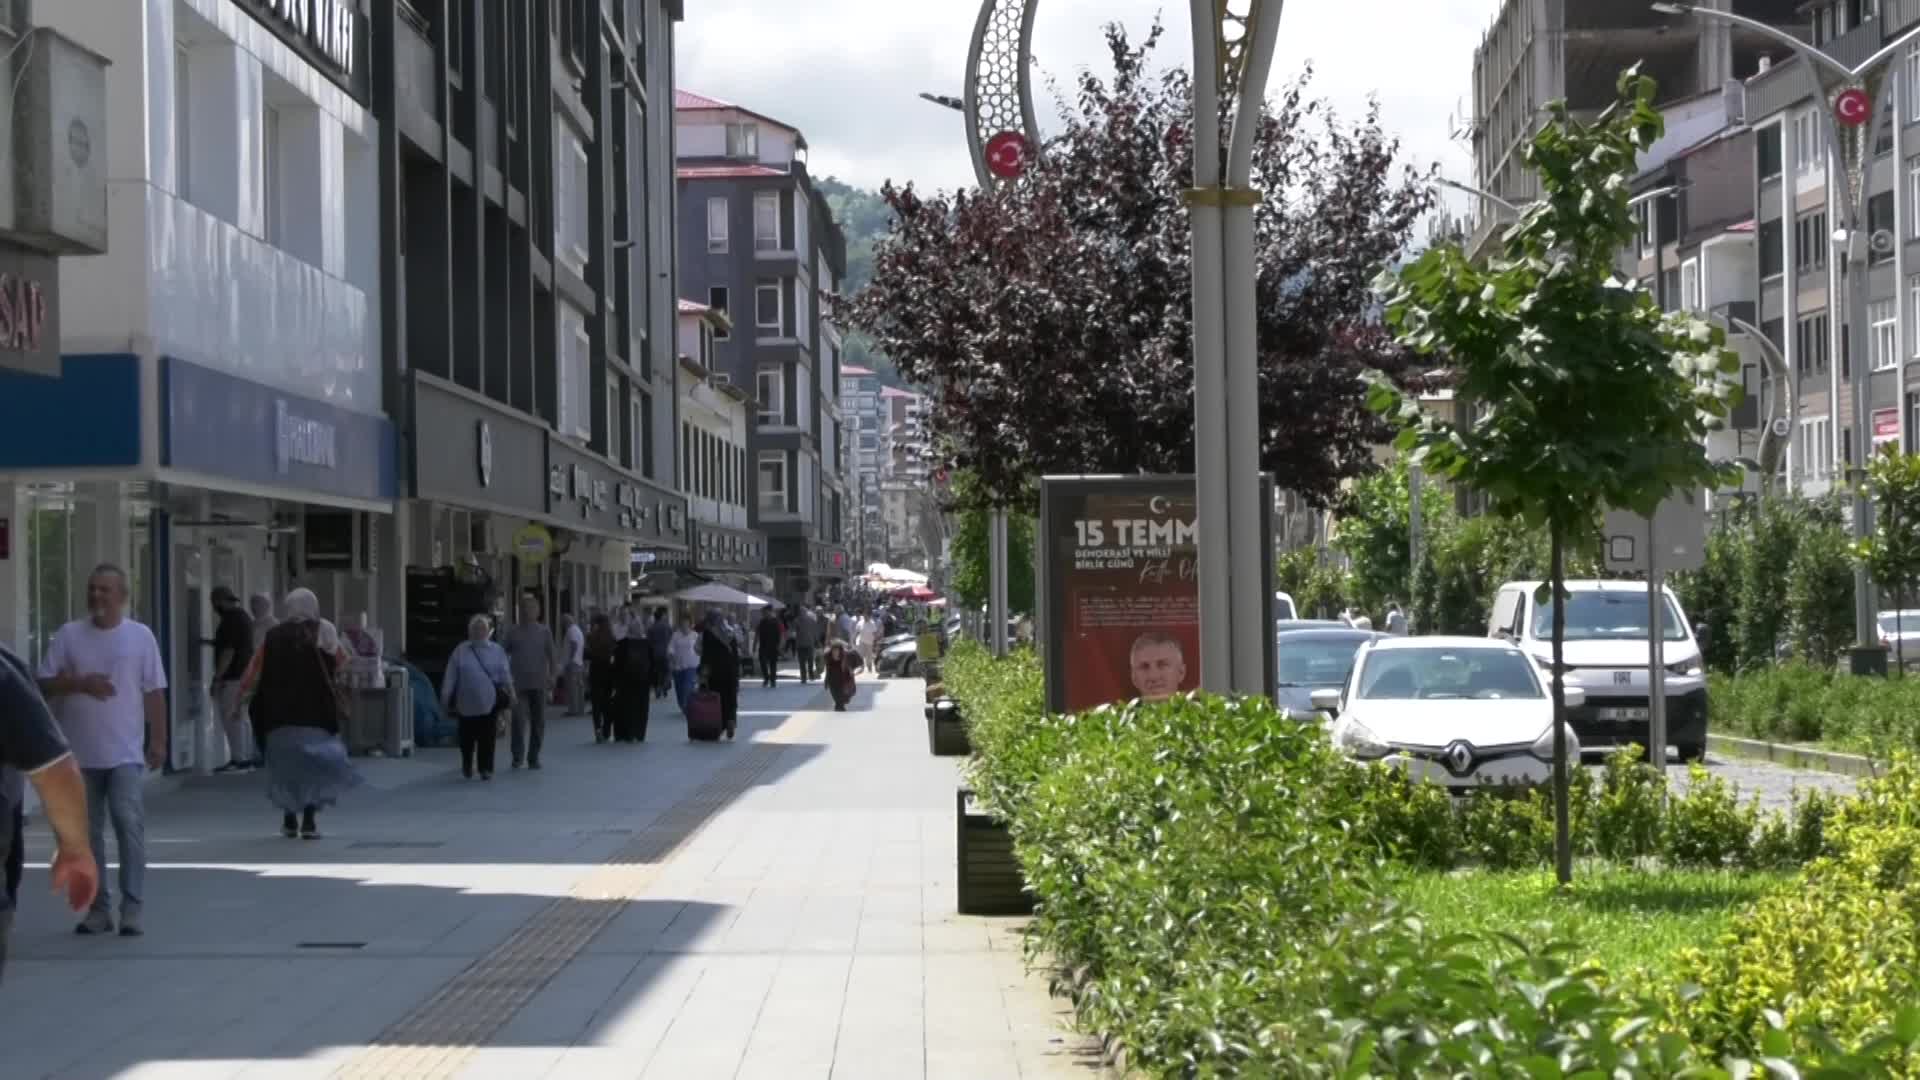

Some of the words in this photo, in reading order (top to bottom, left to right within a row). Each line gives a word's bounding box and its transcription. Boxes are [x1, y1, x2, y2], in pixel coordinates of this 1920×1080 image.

[1075, 520, 1104, 546] 15
[1113, 519, 1199, 545] TEMM
[1075, 547, 1130, 559] DEMOKRASİ
[1133, 549, 1145, 558] VE
[1075, 559, 1104, 570] BİRLİK
[1107, 558, 1134, 569] GÜNÜ
